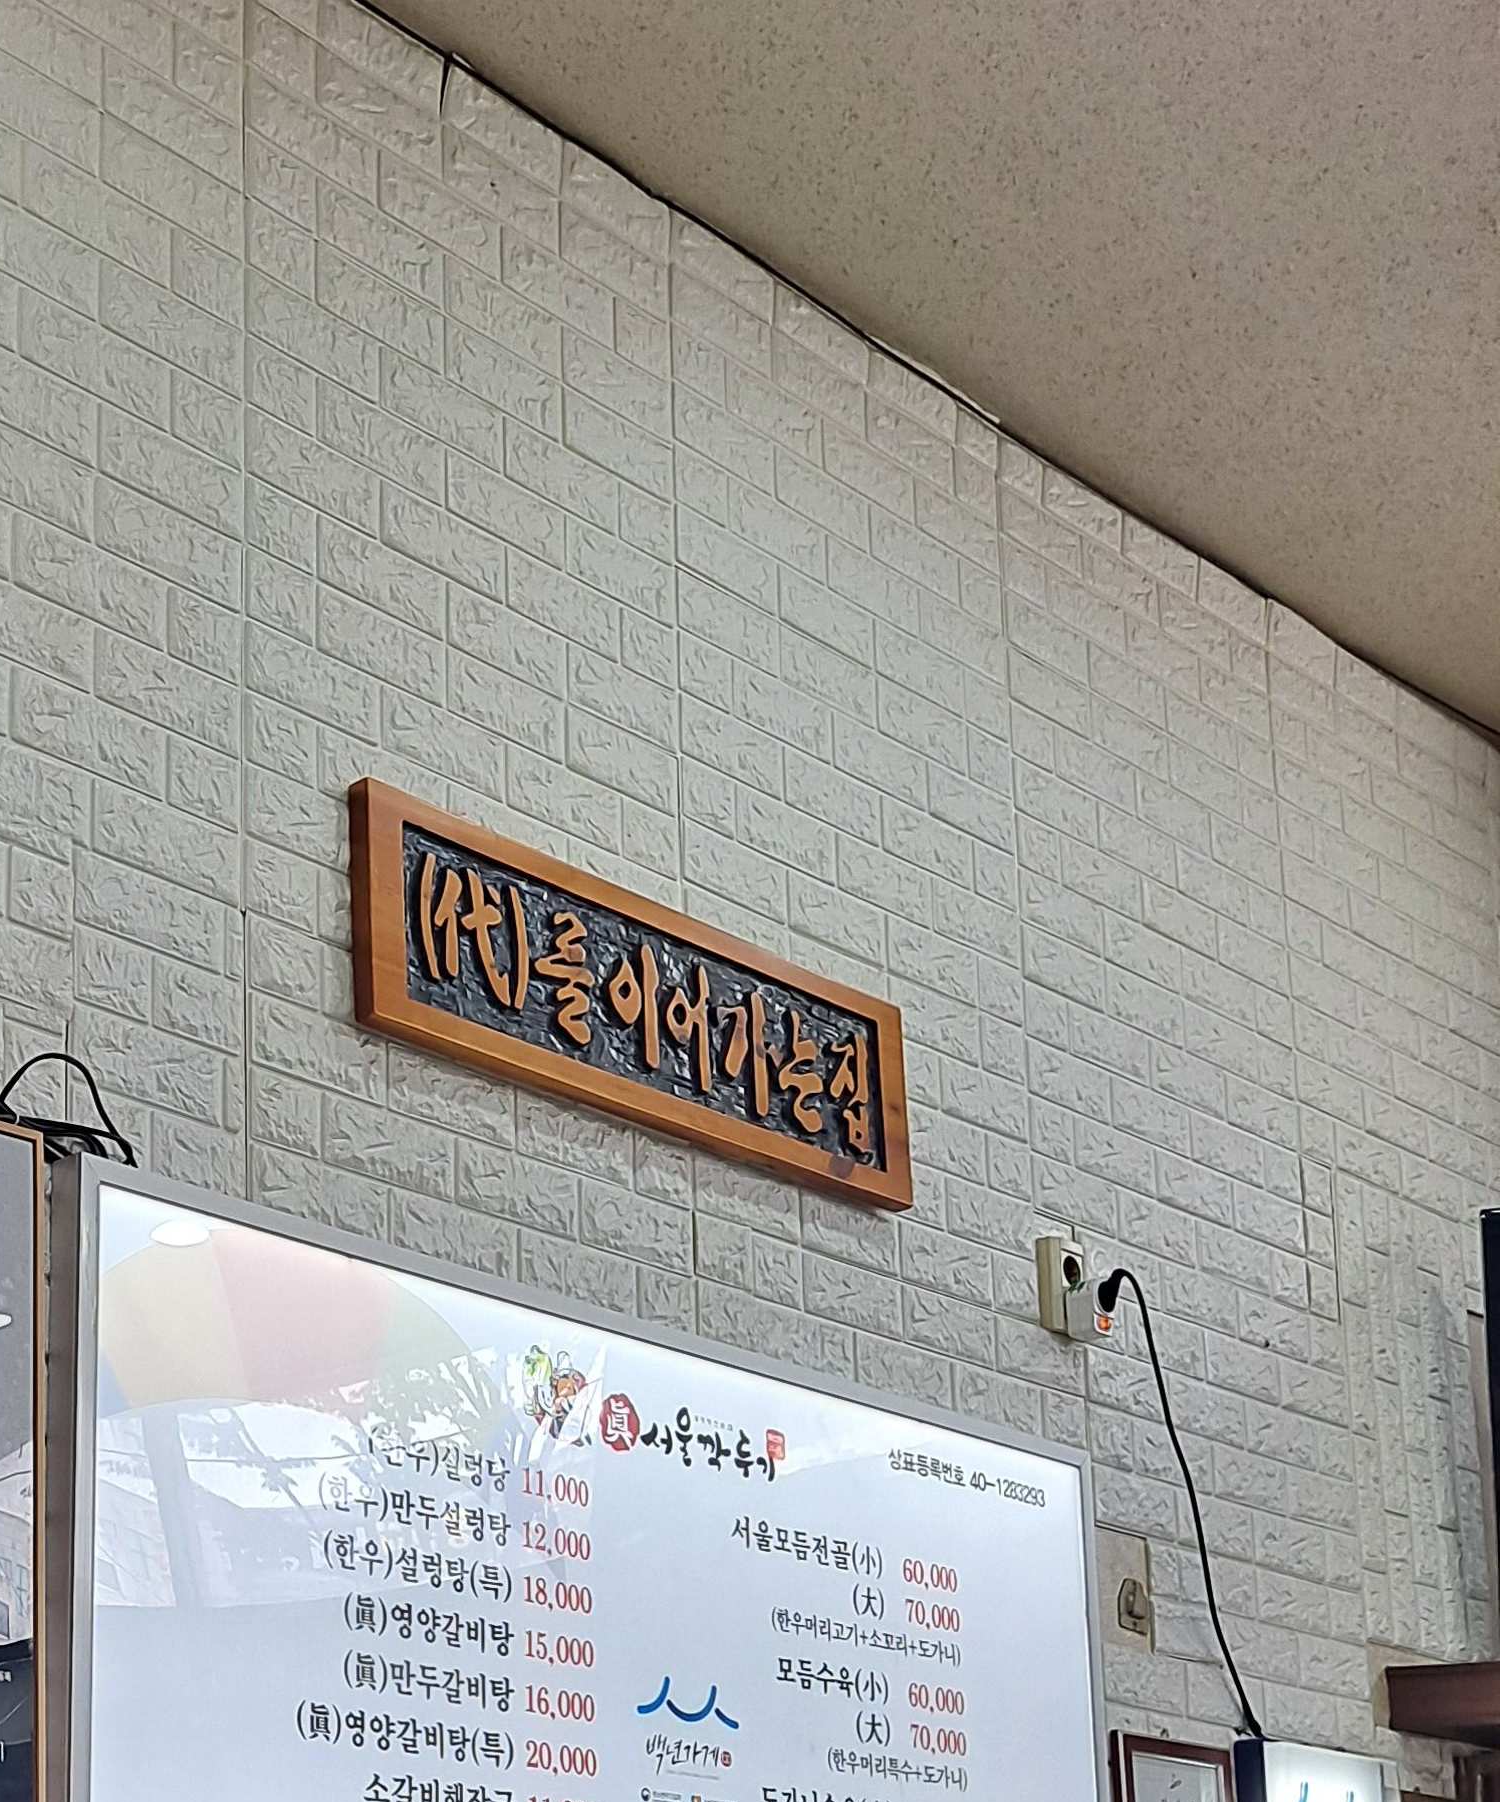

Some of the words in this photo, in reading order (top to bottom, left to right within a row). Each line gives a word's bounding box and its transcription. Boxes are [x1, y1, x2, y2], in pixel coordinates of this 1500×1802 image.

[640, 1406, 775, 1482] 서울깍두기
[888, 1448, 966, 1487] 상표등록번호
[318, 1472, 512, 1547] (한우)만두설렁탕
[522, 1520, 591, 1560] 12,000
[522, 1467, 589, 1508] 11,000
[323, 1528, 513, 1603] (한우)설렁탕(특)
[523, 1575, 593, 1615] 18,000
[731, 1516, 883, 1579] 서울모듬전골(小)
[902, 1558, 958, 1593] 60,000
[344, 1591, 515, 1657] (眞)영양갈비탕
[524, 1630, 594, 1668] 15,000
[853, 1583, 885, 1620] (大)
[905, 1598, 961, 1633] 70,000
[343, 1649, 515, 1713] (眞)만두갈비탕
[525, 1684, 596, 1723] 16,000
[776, 1656, 889, 1705] 모듬수육(小)
[908, 1682, 965, 1716] 60,000
[296, 1700, 515, 1770] (眞)영양갈비탕(특)
[526, 1739, 598, 1778] 20,000
[645, 1733, 720, 1776] 백년가게
[855, 1710, 891, 1748] (大)
[910, 1723, 967, 1757] 70,000
